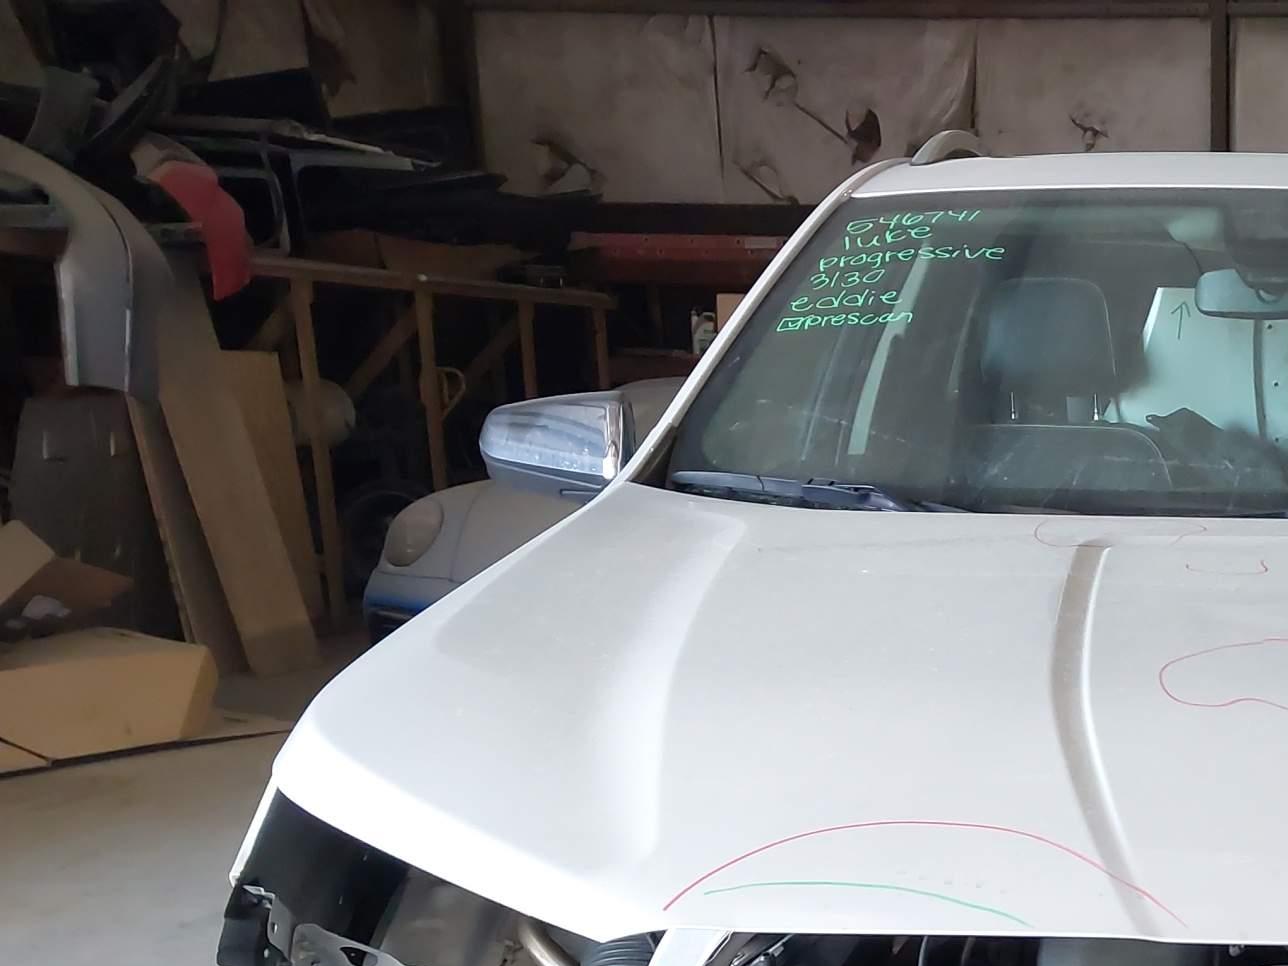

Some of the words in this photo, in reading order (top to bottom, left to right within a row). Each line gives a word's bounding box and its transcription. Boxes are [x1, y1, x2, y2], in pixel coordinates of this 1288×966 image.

[819, 243, 1005, 271] progressive
[790, 289, 903, 311] eddie
[803, 311, 913, 330] prescan
